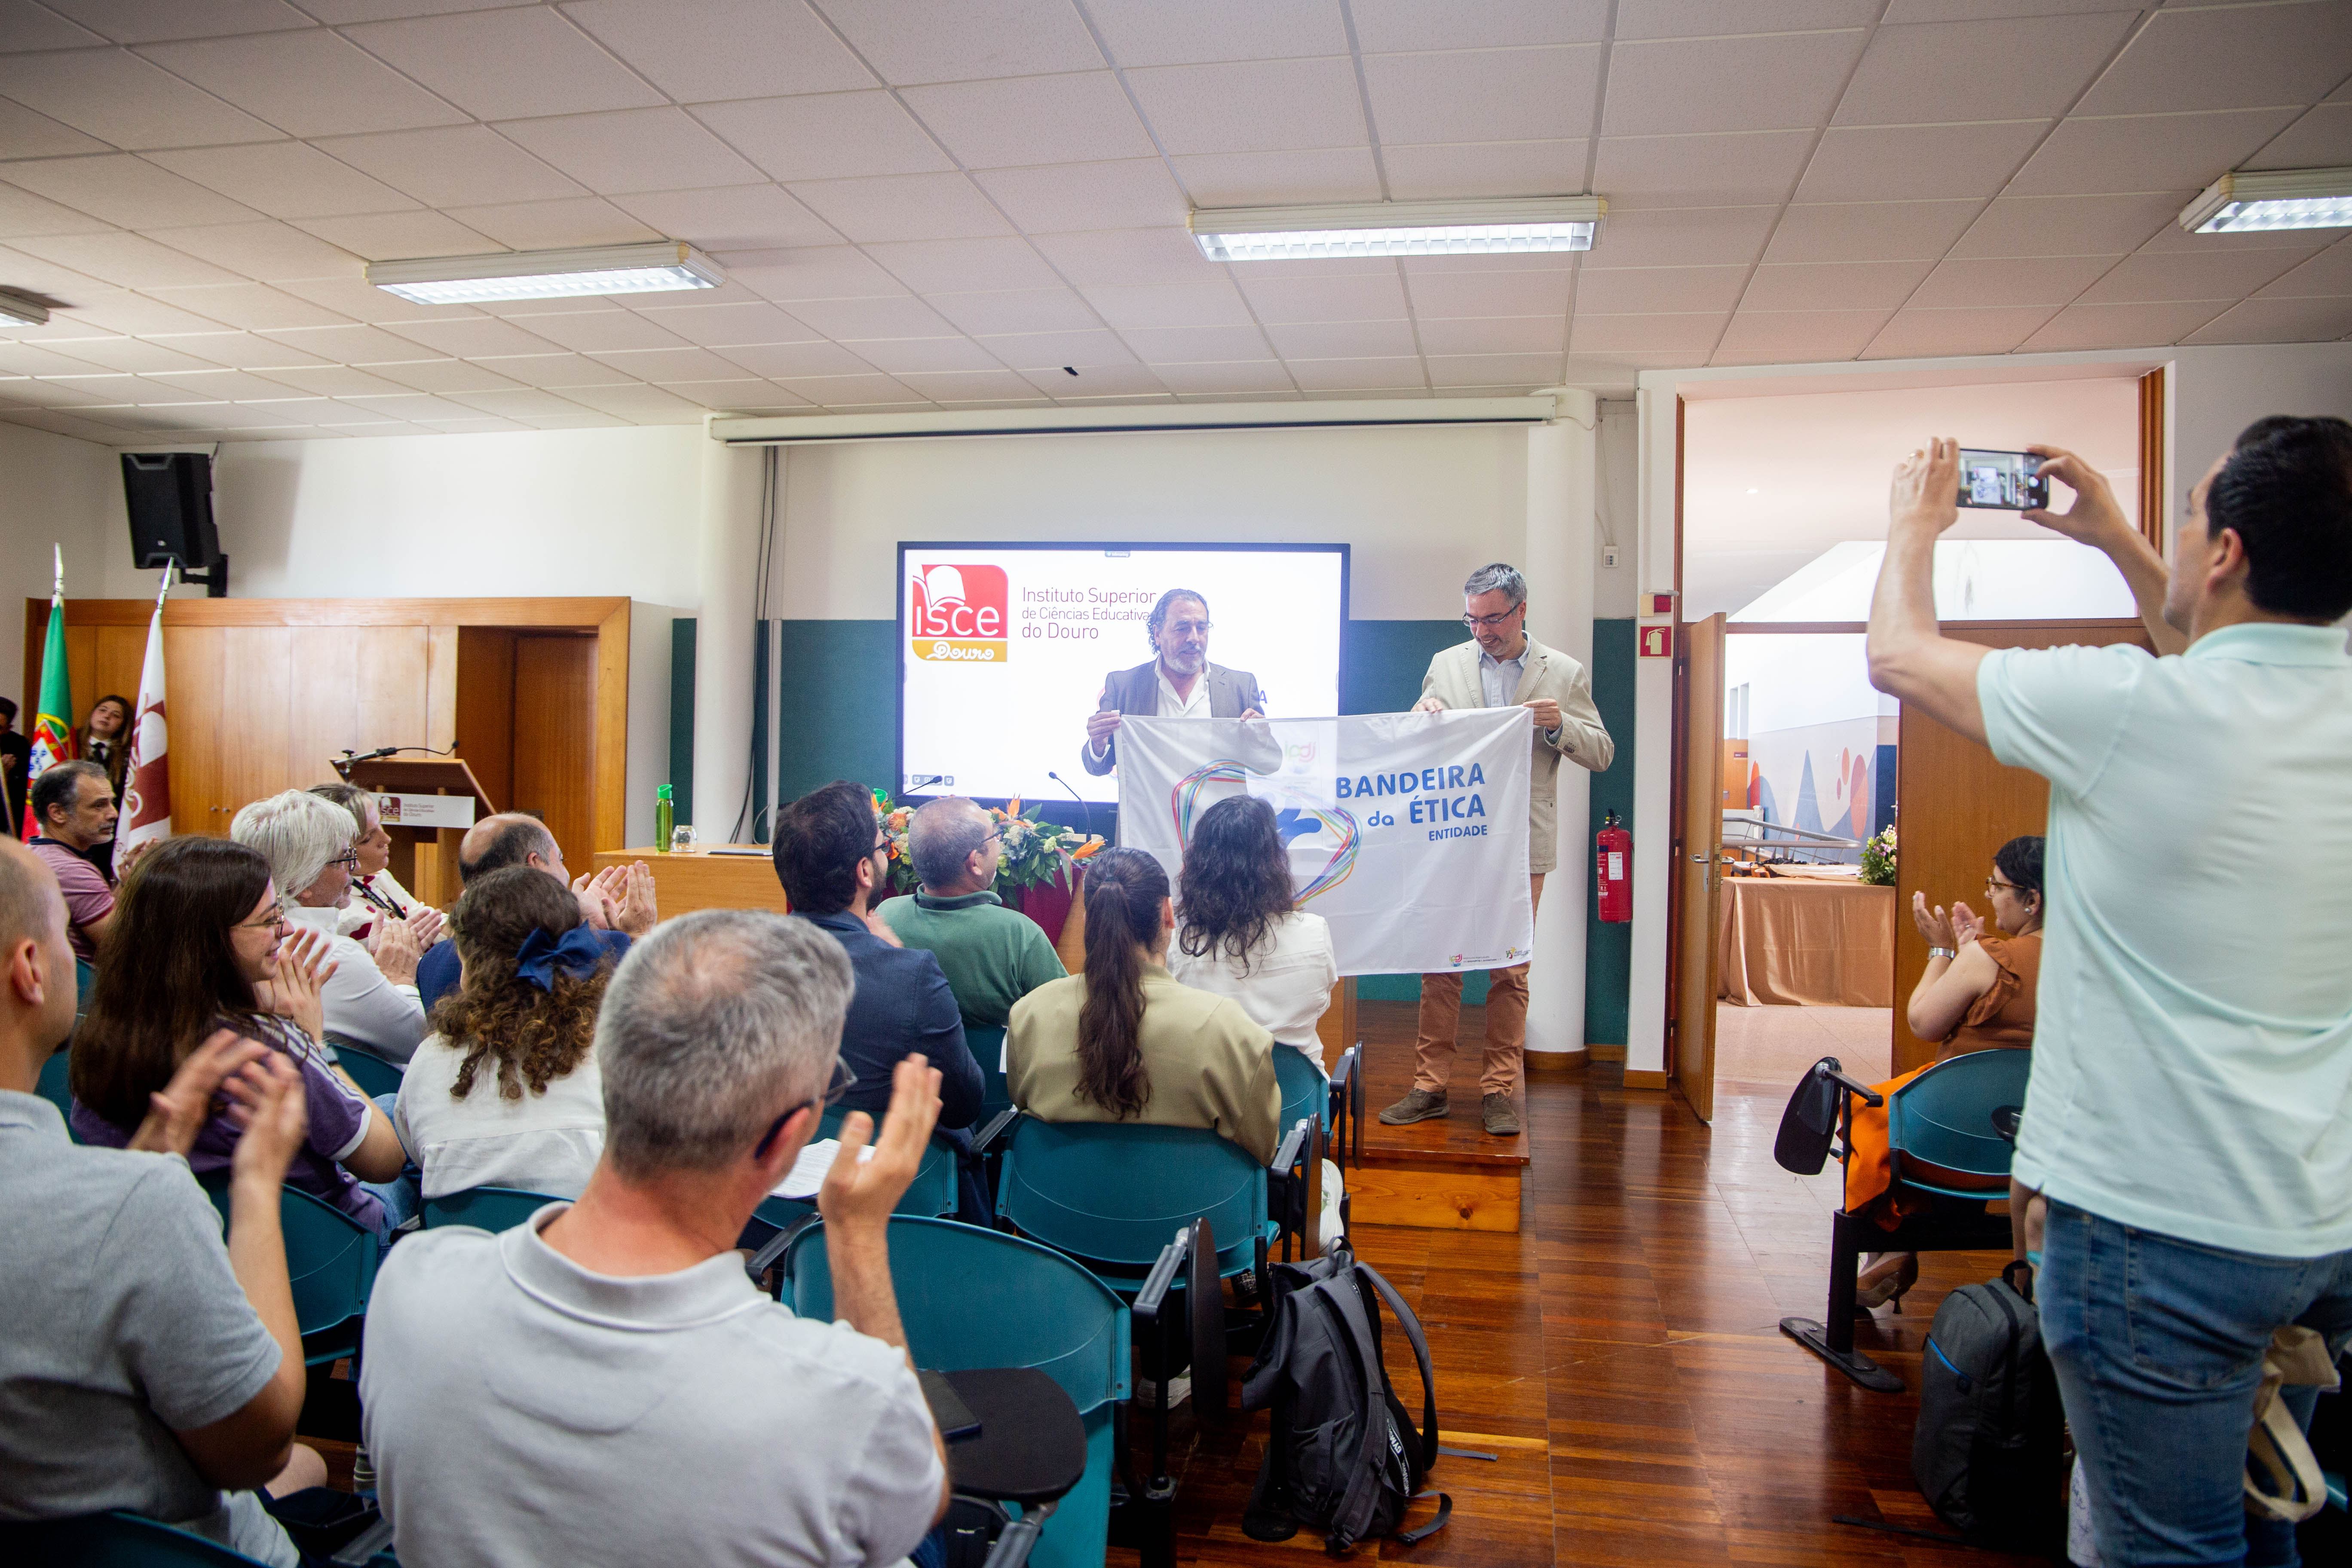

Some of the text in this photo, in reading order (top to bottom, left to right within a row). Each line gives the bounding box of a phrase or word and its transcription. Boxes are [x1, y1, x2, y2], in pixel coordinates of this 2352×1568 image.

[1023, 587, 1157, 607] Instituto Superior
[1022, 606, 1150, 621] de Ciências Educativa
[1022, 622, 1099, 639] do Douro
[926, 641, 995, 661] Douro
[1335, 763, 1485, 799] BANDEIRA
[1367, 793, 1486, 827] da ÉTICA
[1428, 824, 1488, 841] ENTIDADE
